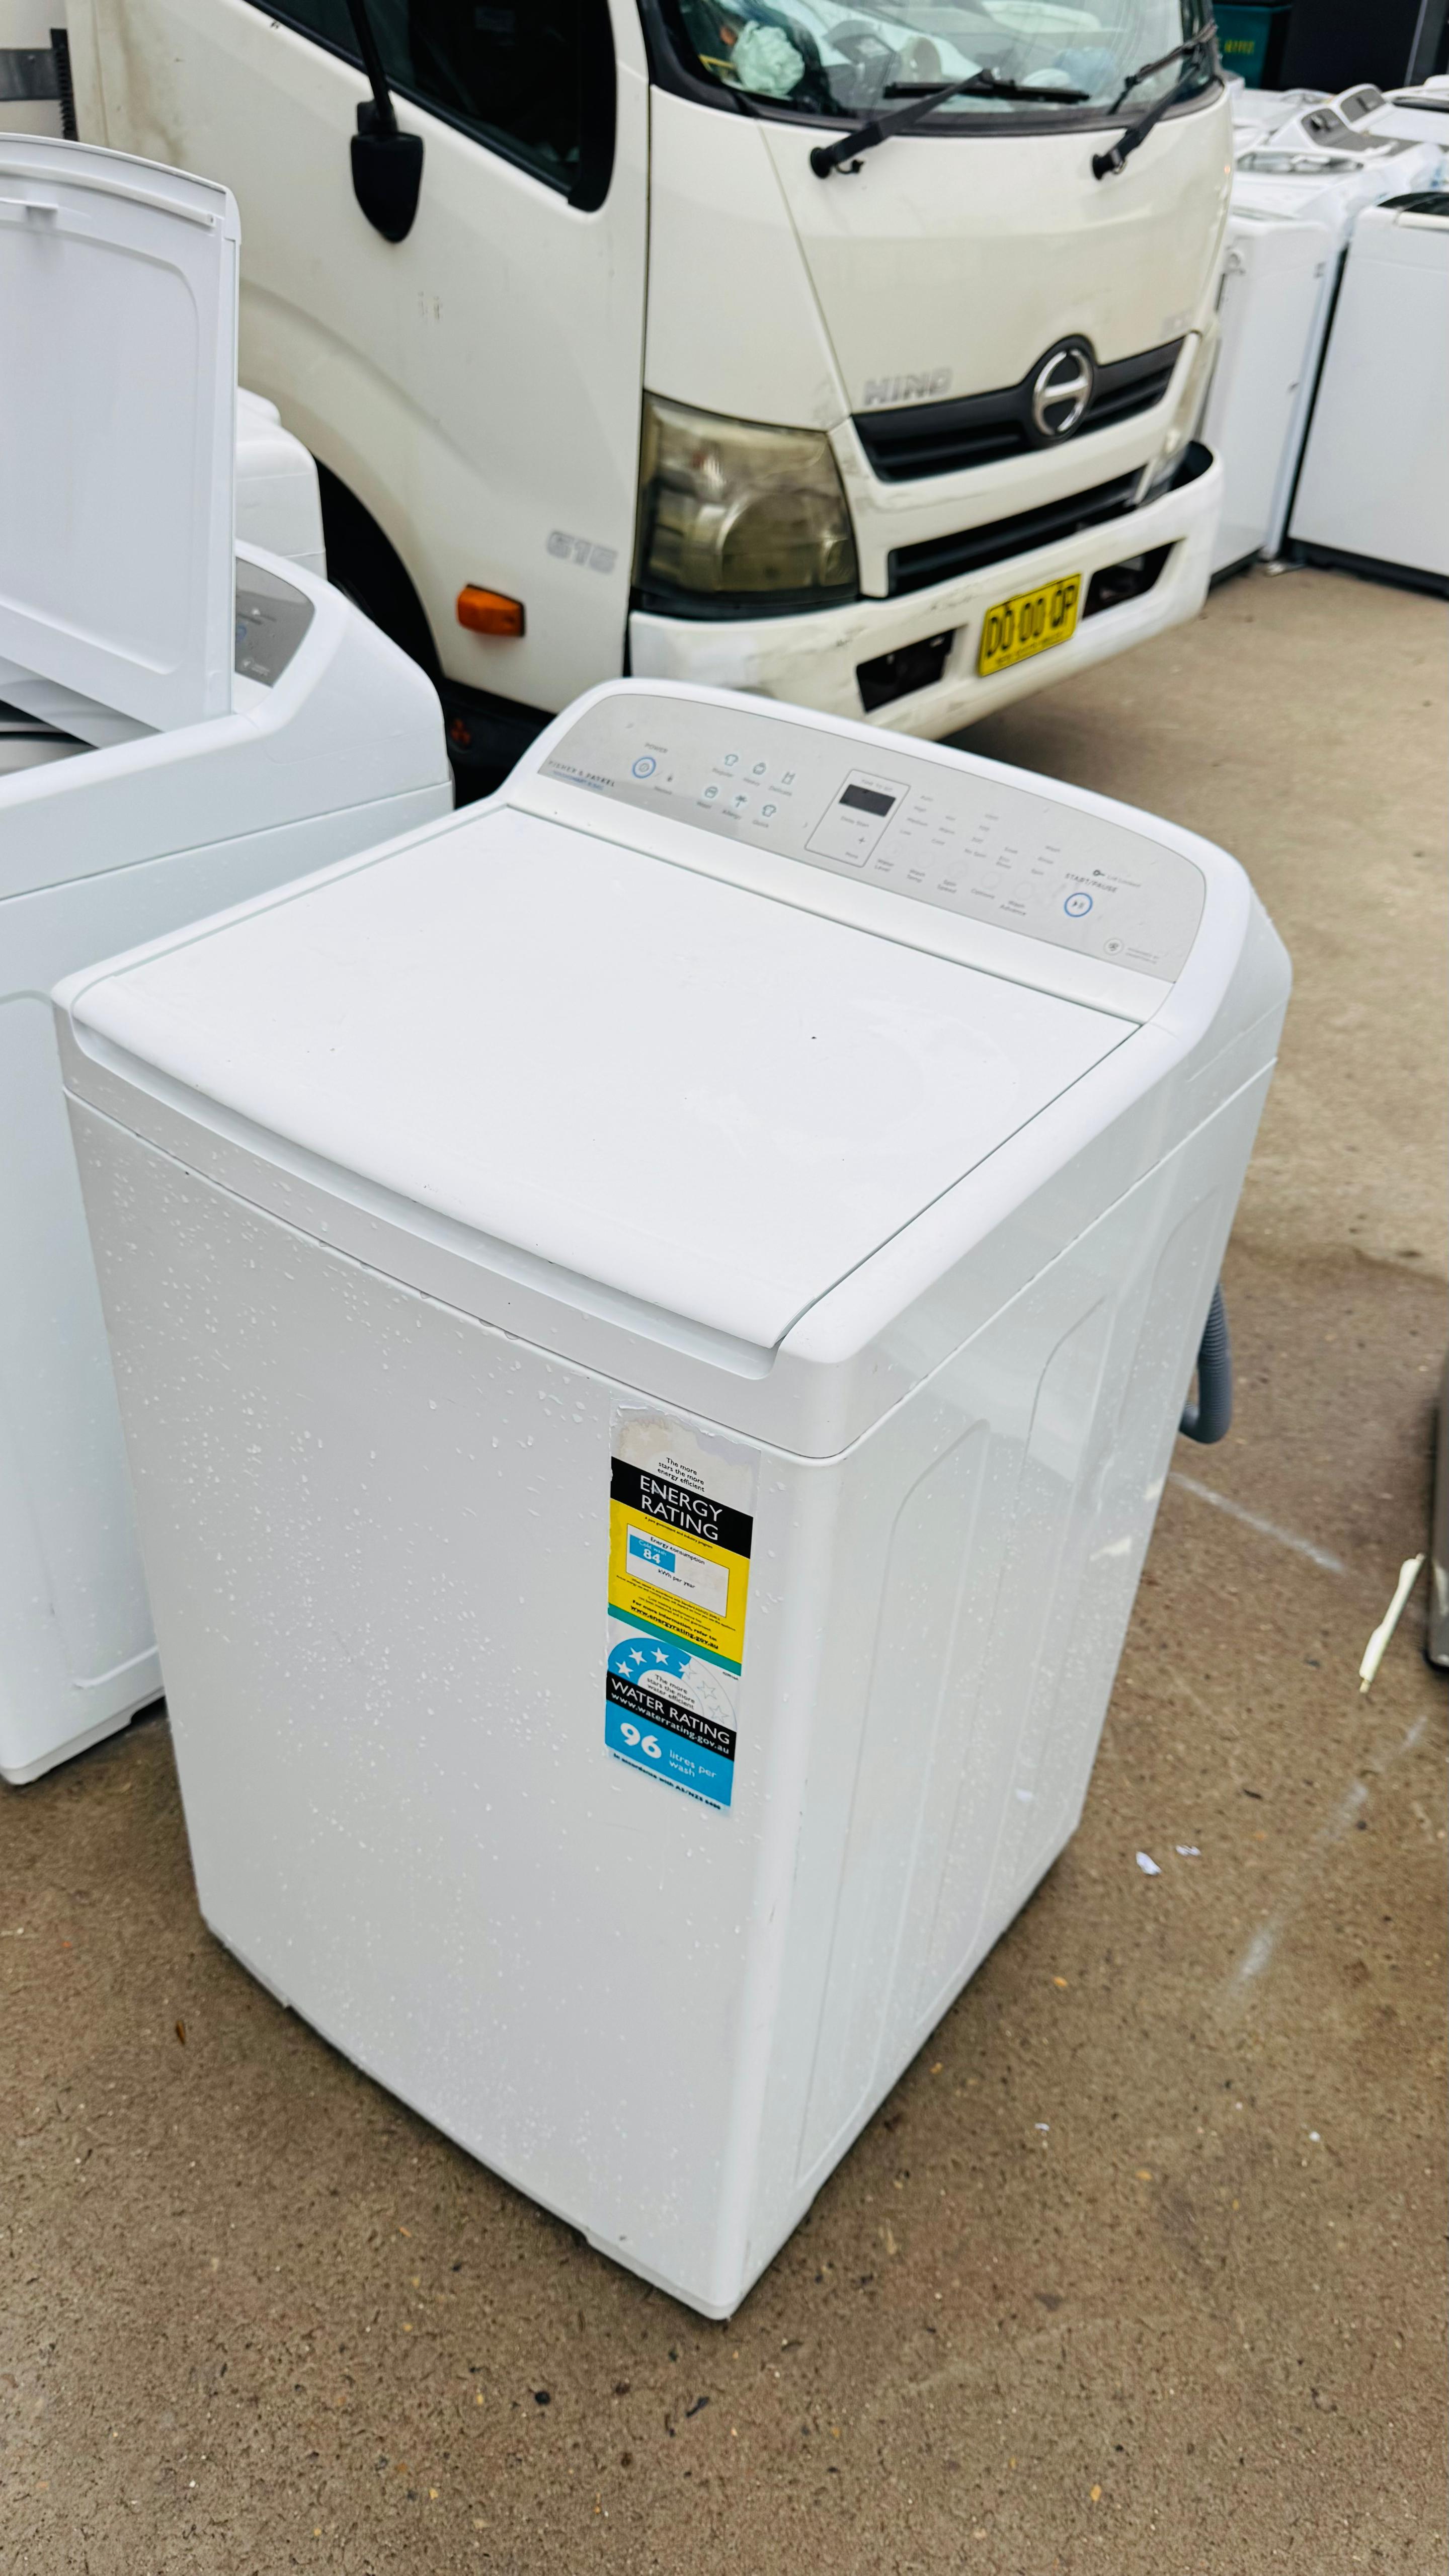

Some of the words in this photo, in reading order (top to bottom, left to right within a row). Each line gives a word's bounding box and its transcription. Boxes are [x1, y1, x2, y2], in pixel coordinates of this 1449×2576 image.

[863, 368, 954, 404] HINO
[645, 743, 668, 754] POWER
[548, 760, 576, 773] FISHER
[586, 772, 615, 787] PAYKEL
[1065, 873, 1117, 894] START/PAUSE
[659, 1462, 673, 1472] stars
[675, 1469, 685, 1477] the
[687, 1475, 704, 1485] more
[666, 1457, 678, 1467] The
[680, 1464, 697, 1475] more
[658, 1469, 678, 1481] energy
[680, 1478, 705, 1492] efficient
[640, 1475, 722, 1522] ENERGY
[642, 1494, 718, 1541] RATING
[638, 1540, 652, 1549] Cold
[654, 1548, 667, 1556] wash
[643, 1549, 661, 1564] 84
[651, 1537, 669, 1549] Energy
[670, 1547, 705, 1565] consumption
[658, 1569, 672, 1578] kWh
[630, 1605, 718, 1650] www.energyrating.gov.au
[643, 1605, 657, 1614] more
[659, 1612, 692, 1631] information,
[694, 1629, 707, 1637] refer
[647, 1678, 662, 1688] stars
[665, 1686, 675, 1695] the
[677, 1692, 695, 1704] more
[648, 1684, 666, 1695] water
[668, 1694, 694, 1710] efficient
[655, 1674, 668, 1684] The
[670, 1682, 688, 1695] more
[611, 1678, 665, 1714] WATER
[670, 1707, 730, 1744] RATING
[611, 1693, 729, 1754] www.waterrating.gov.au
[620, 1722, 662, 1758] 96
[669, 1749, 695, 1768] litres
[698, 1765, 716, 1778] per
[669, 1760, 695, 1778] wash
[621, 1758, 657, 1779] accordance
[659, 1778, 674, 1787] with
[675, 1786, 703, 1802] AS/NZS
